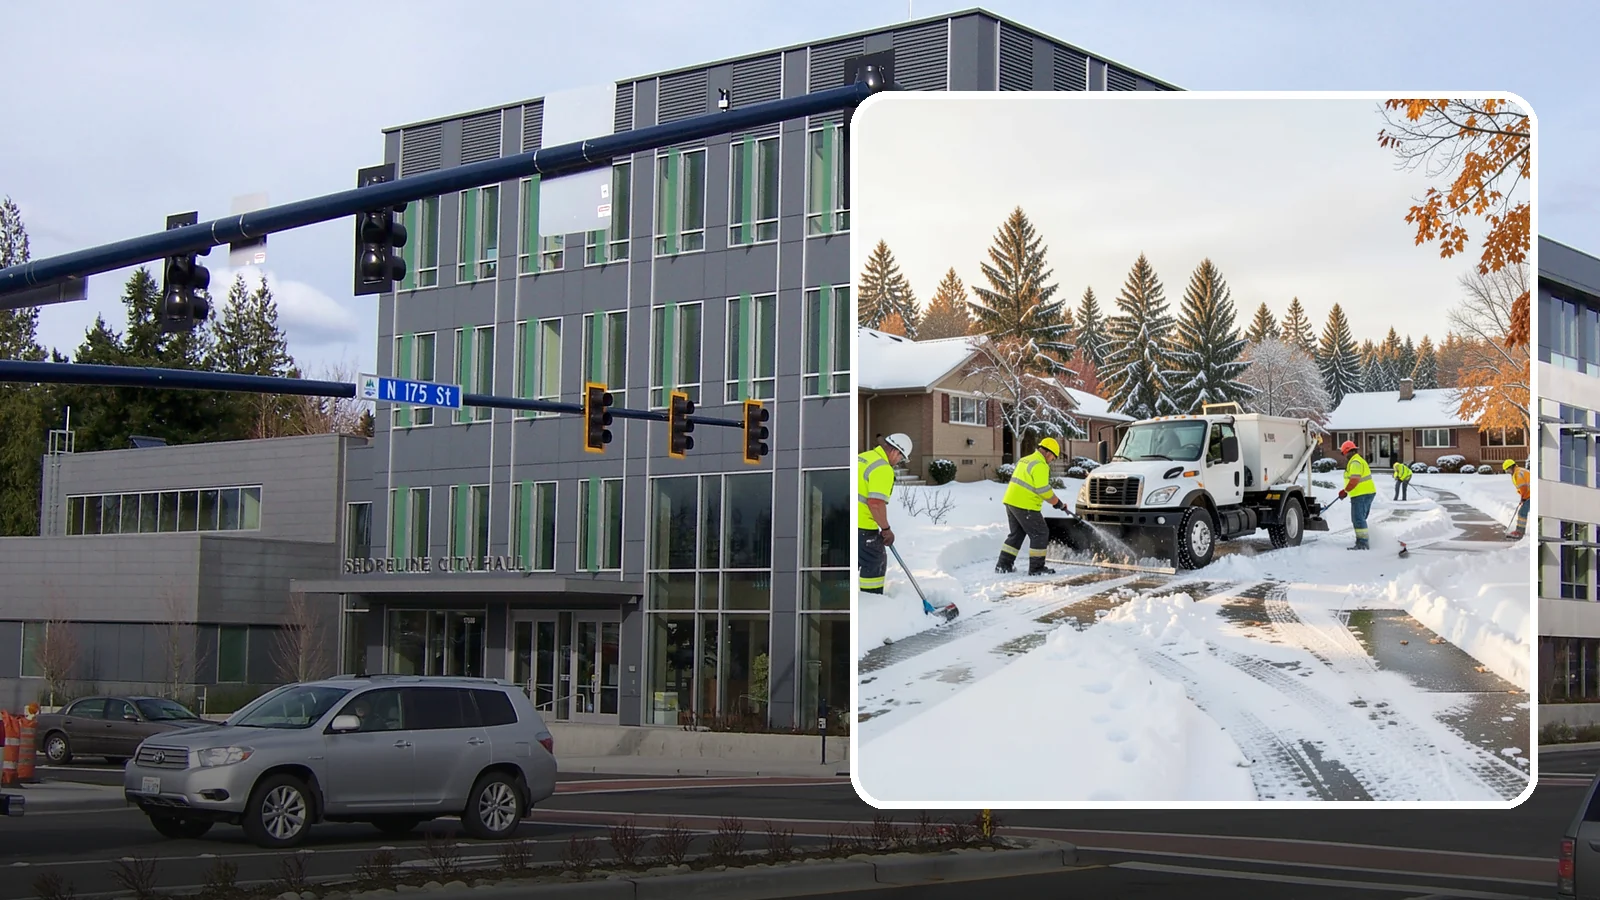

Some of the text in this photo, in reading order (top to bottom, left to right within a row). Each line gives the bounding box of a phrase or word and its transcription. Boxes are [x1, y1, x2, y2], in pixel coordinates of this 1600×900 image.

[387, 380, 451, 406] N 175 St
[344, 555, 526, 574] SHORELINE CITY HALL
